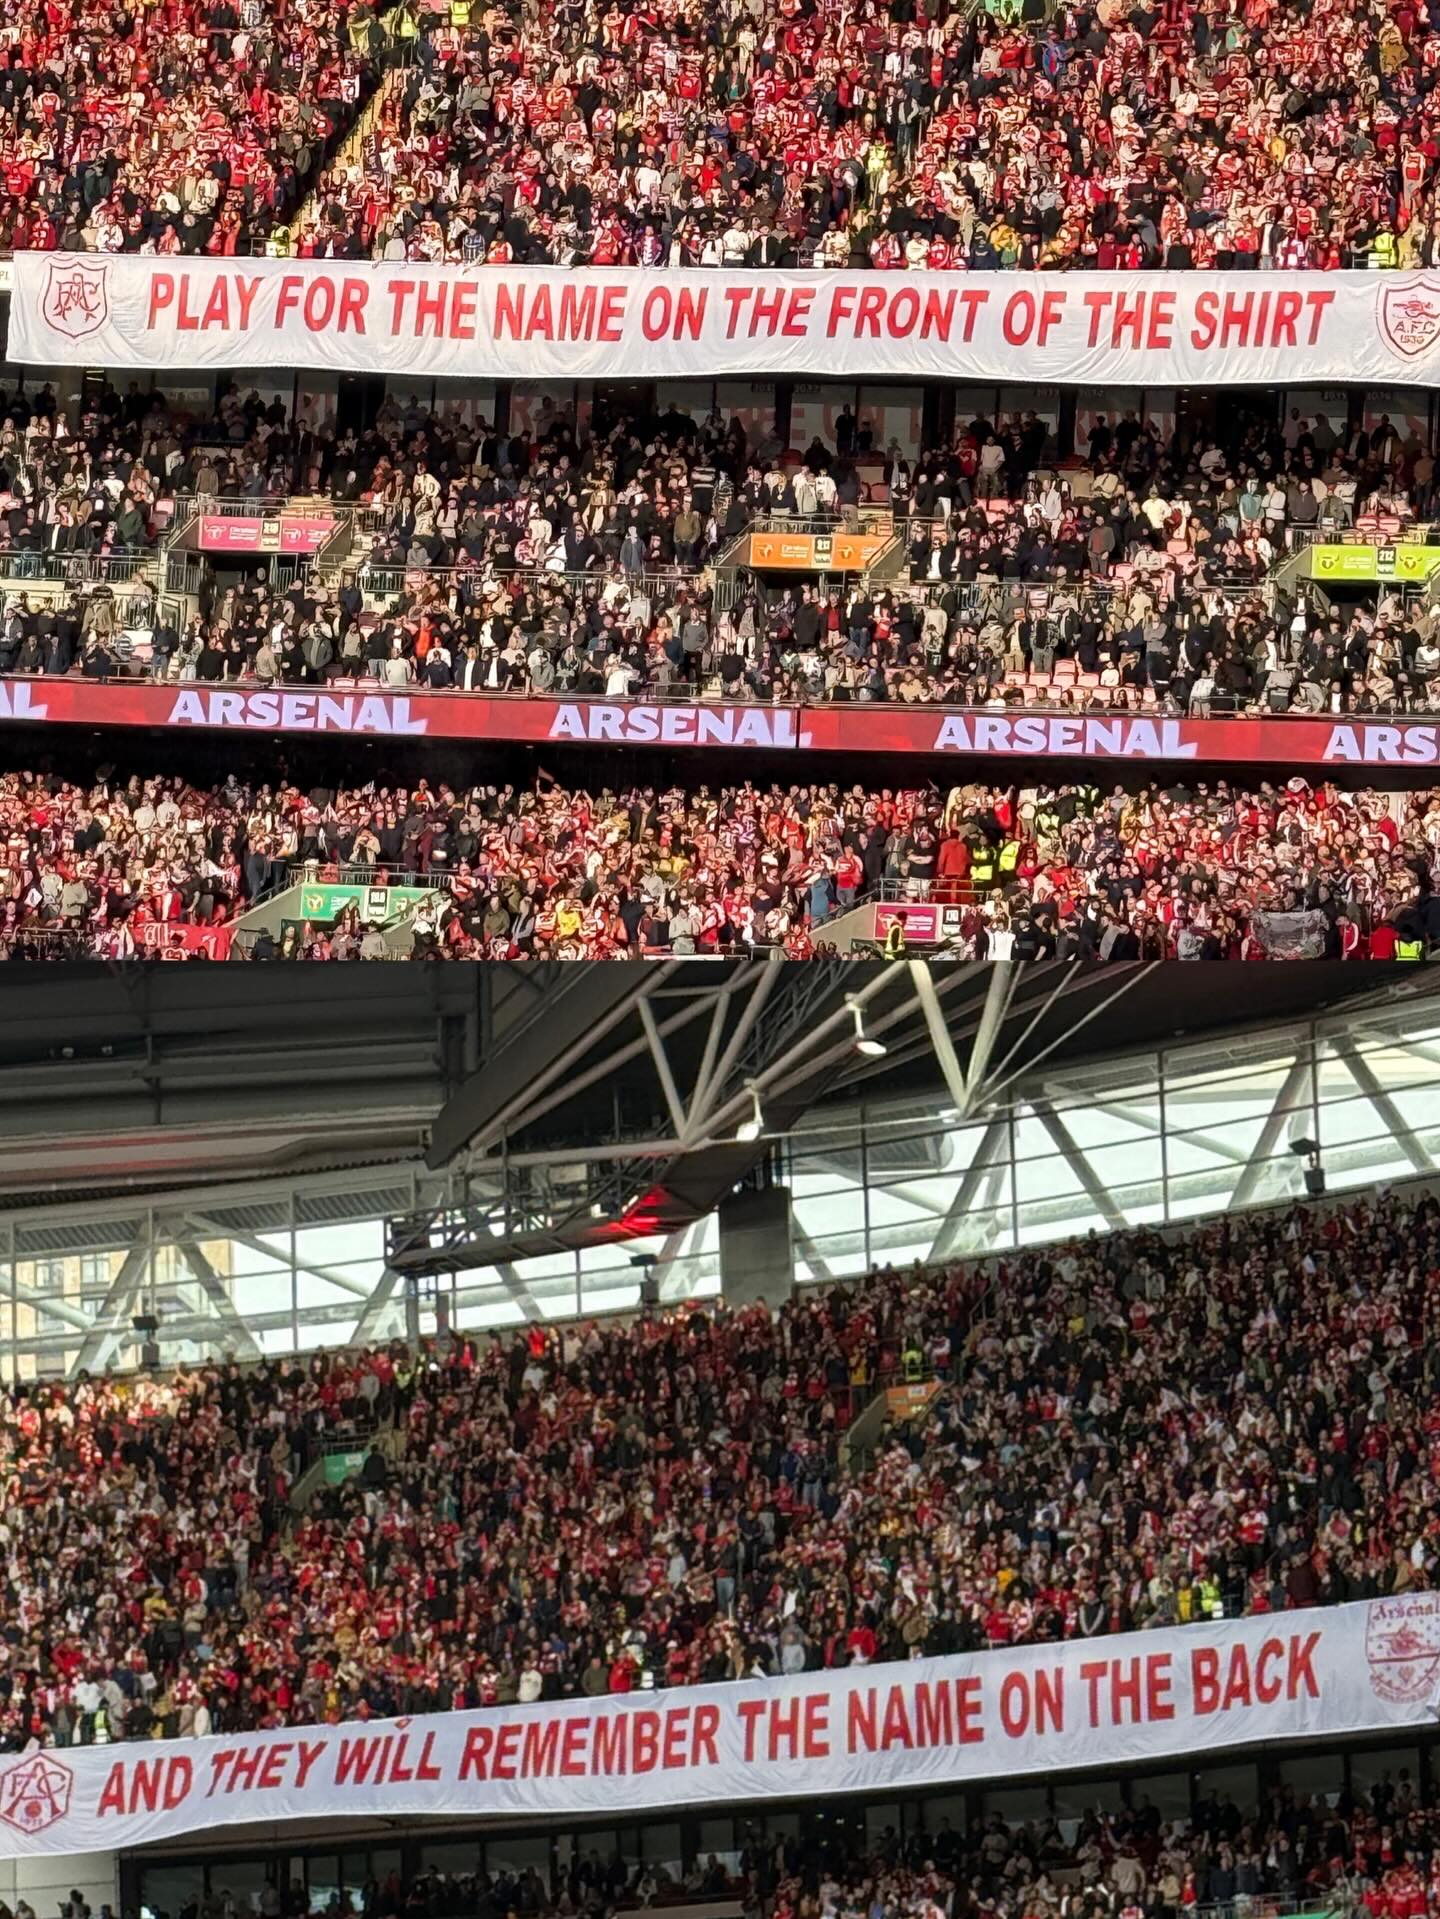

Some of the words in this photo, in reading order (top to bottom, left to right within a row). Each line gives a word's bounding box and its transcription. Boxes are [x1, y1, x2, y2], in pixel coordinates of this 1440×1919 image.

[147, 273, 263, 331] PLAY
[275, 275, 369, 334] FOR
[387, 279, 477, 340] THE
[494, 284, 627, 343] NAME
[642, 286, 709, 341] ON
[724, 287, 816, 338] THE
[826, 286, 989, 342] FRONT
[1002, 291, 1066, 347] OF
[1084, 291, 1177, 349] THE
[1190, 290, 1334, 350] SHIRT
[167, 690, 427, 735] ARSENAL
[548, 704, 811, 749] ARSENAL
[934, 716, 1198, 759] ARSENAL
[1322, 725, 1438, 763] ARS
[97, 1756, 193, 1817] AND
[205, 1740, 328, 1798] THEY
[334, 1729, 442, 1785] WILL
[459, 1704, 720, 1781] REMEMBER
[737, 1692, 829, 1762] THE
[847, 1677, 984, 1754] NAME
[1001, 1667, 1064, 1739] ON
[1079, 1653, 1175, 1729] THE
[1192, 1632, 1322, 1716] BACK
